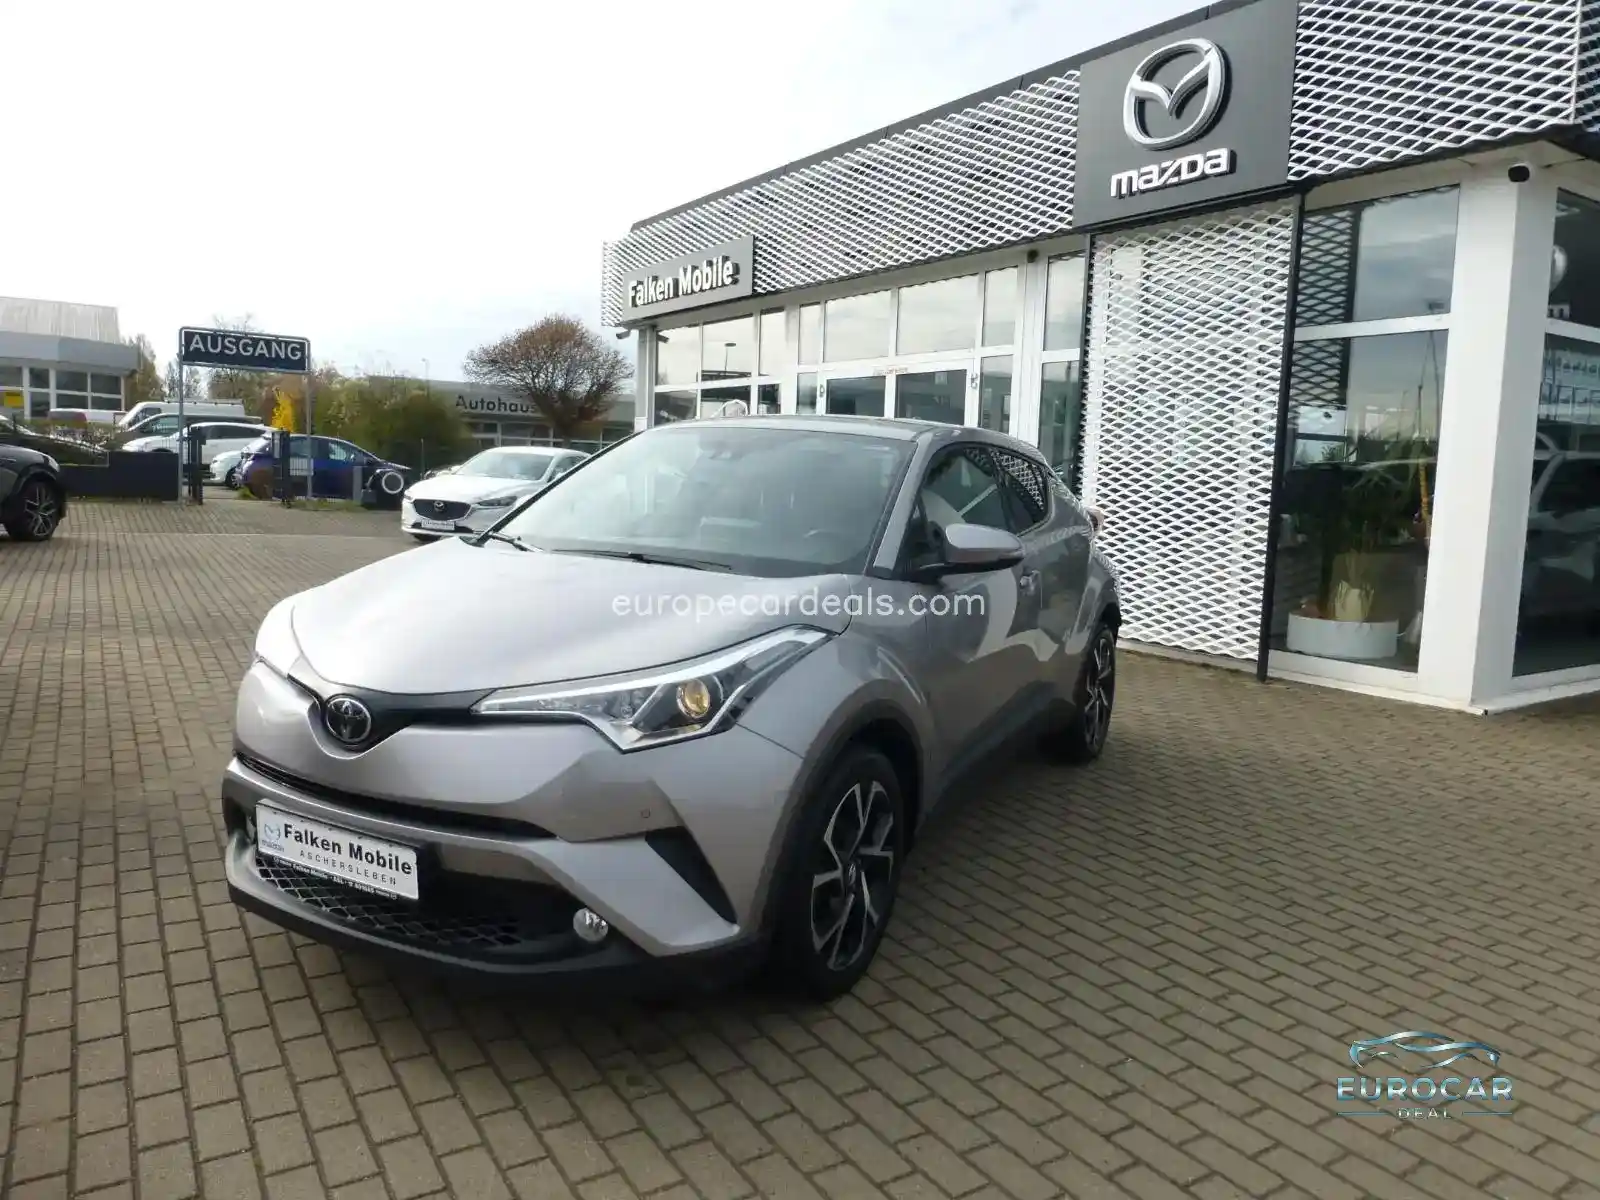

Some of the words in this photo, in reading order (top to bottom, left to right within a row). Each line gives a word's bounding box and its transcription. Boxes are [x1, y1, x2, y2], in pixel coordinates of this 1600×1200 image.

[628, 278, 674, 307] Falken
[679, 255, 734, 296] Mobile
[189, 334, 301, 360] AUSGANG
[283, 823, 342, 854] Falken
[349, 842, 412, 875] Mobile
[300, 850, 396, 885] ASCHERSLEBEN
